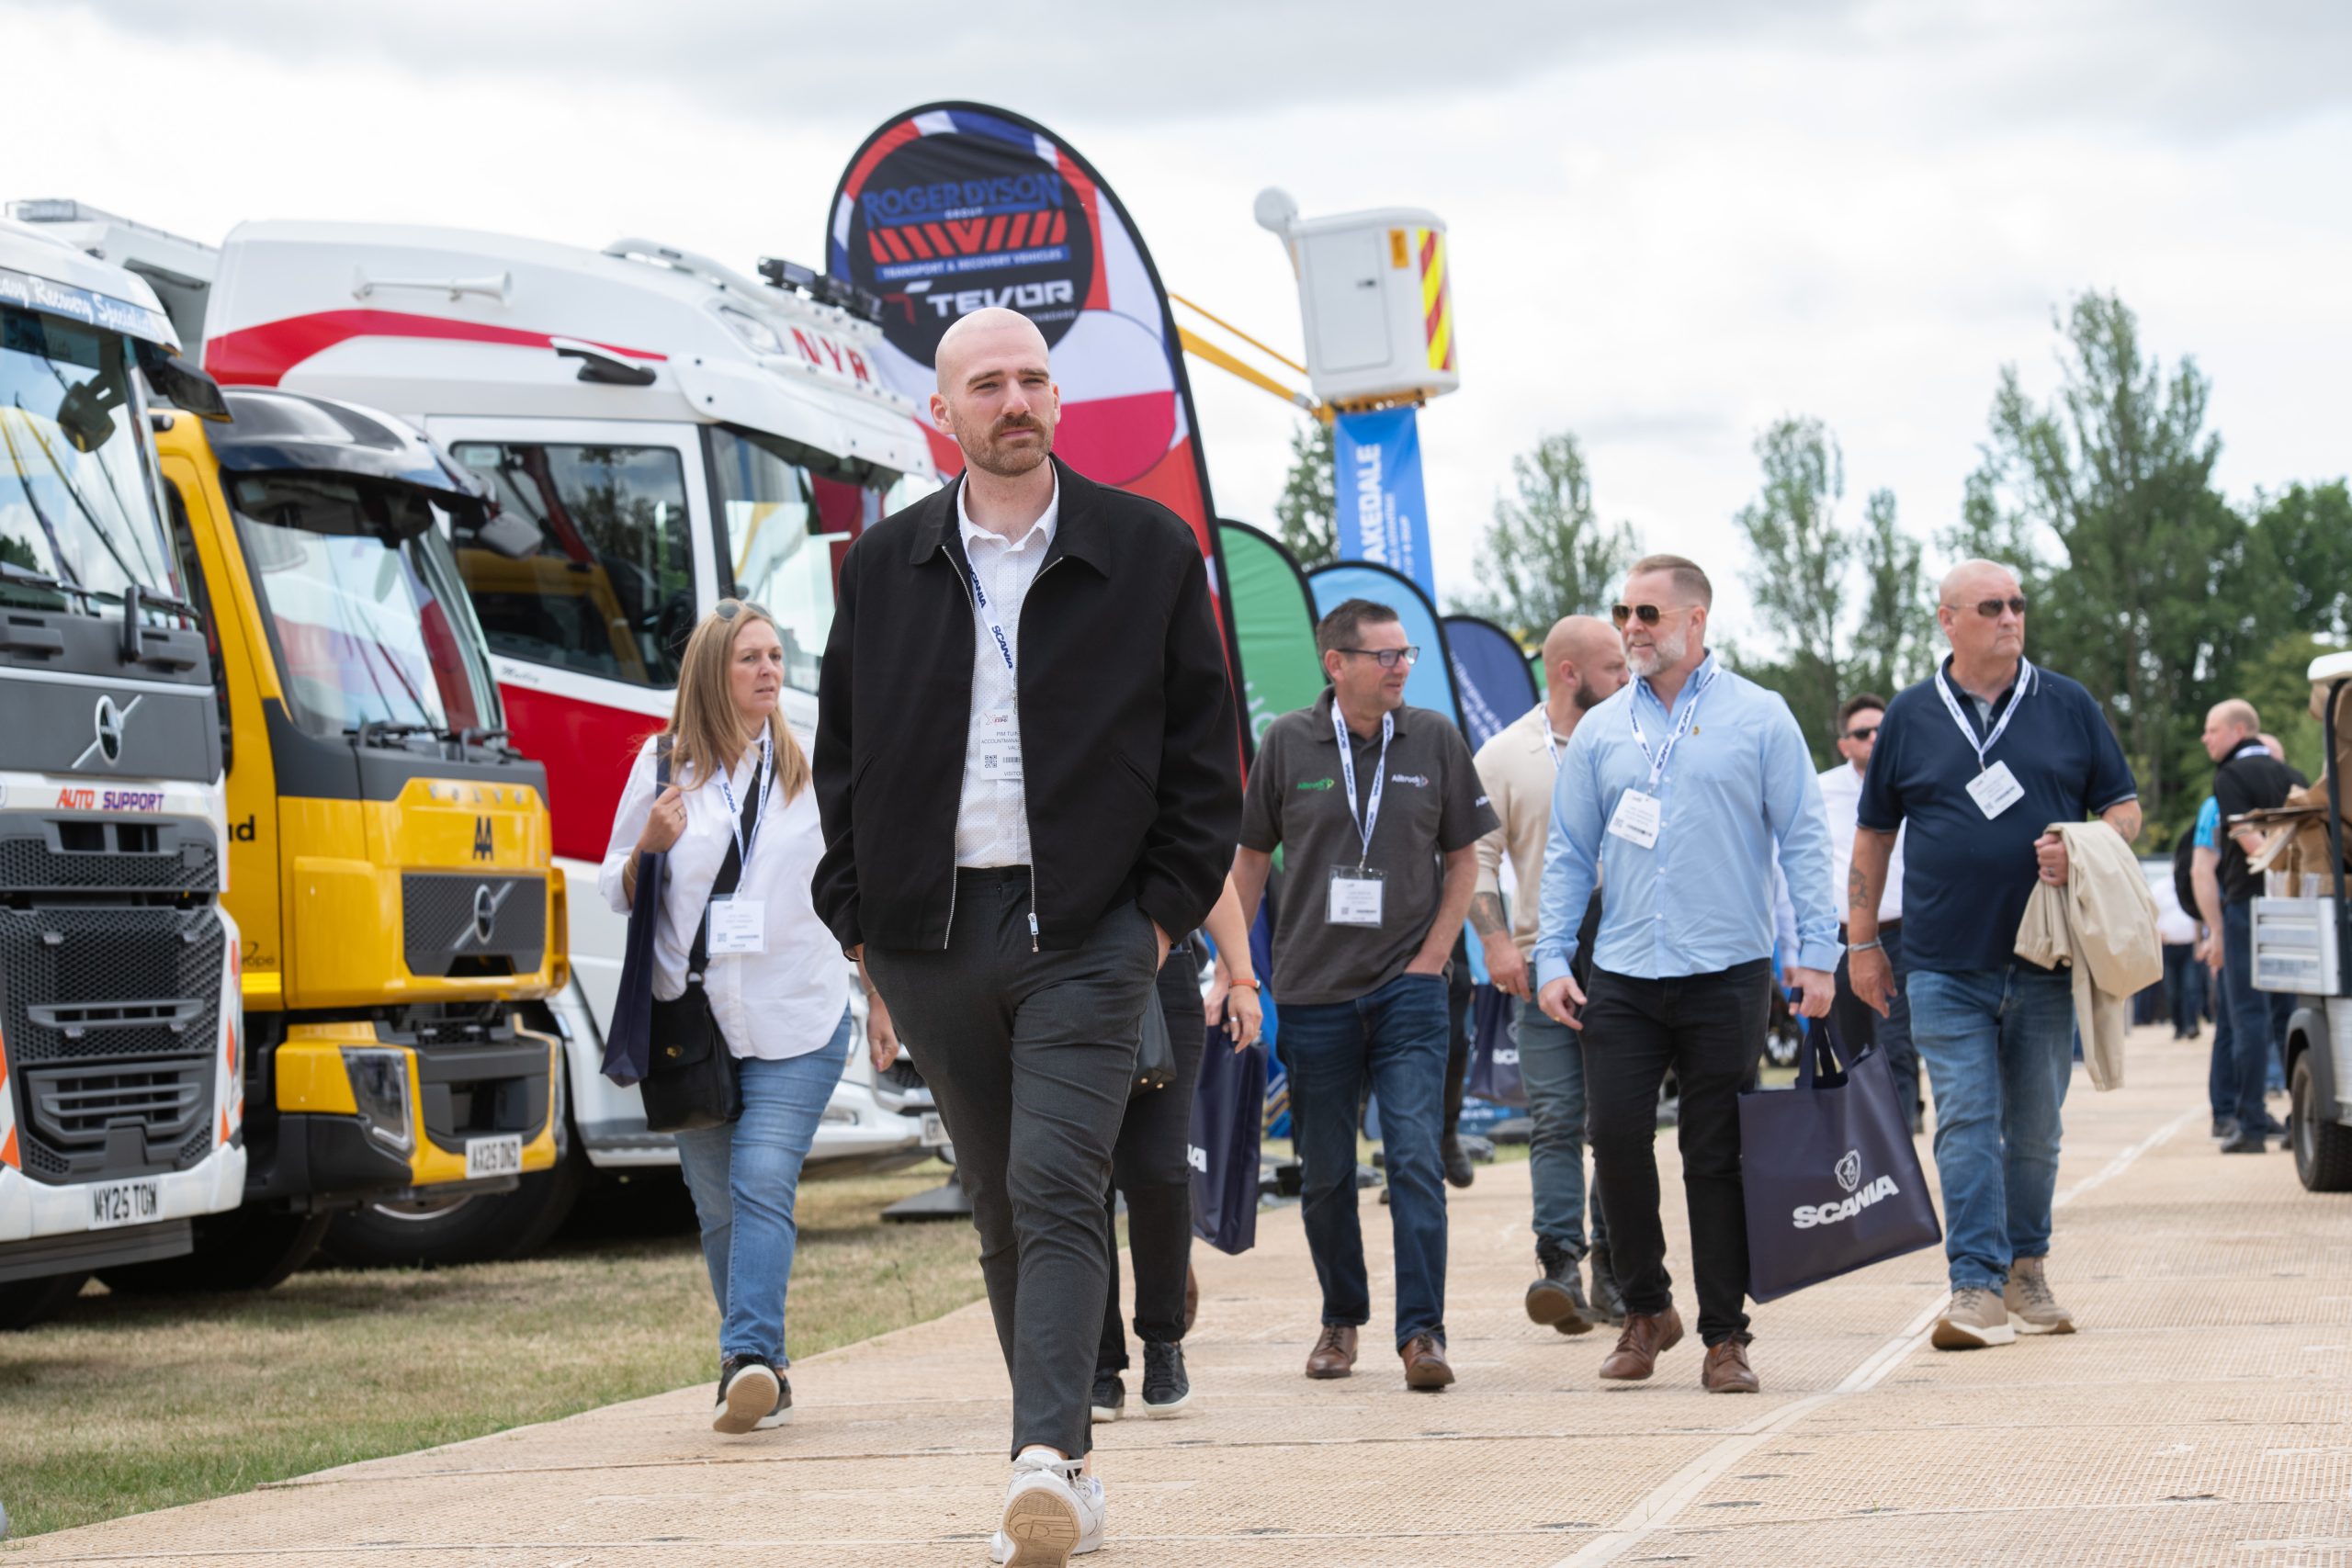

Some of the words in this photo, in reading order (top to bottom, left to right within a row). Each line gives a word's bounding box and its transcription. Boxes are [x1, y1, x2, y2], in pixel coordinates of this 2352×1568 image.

[861, 184, 963, 229] ROGER
[963, 173, 1064, 209] DYSON
[944, 206, 984, 220] GROUP
[882, 261, 944, 279] TRANSPORT
[946, 260, 956, 272] &
[957, 254, 1011, 270] RECOVERY
[1012, 249, 1063, 265] VEHICLES
[925, 278, 1074, 318] TEVOR
[1355, 443, 1388, 564] AKEDALE
[991, 625, 1013, 670] SCANIA
[56, 786, 96, 809] AUTO
[103, 791, 164, 812] SUPPORT
[722, 783, 737, 814] SCANIA
[1792, 1174, 1900, 1229] SCANIA
